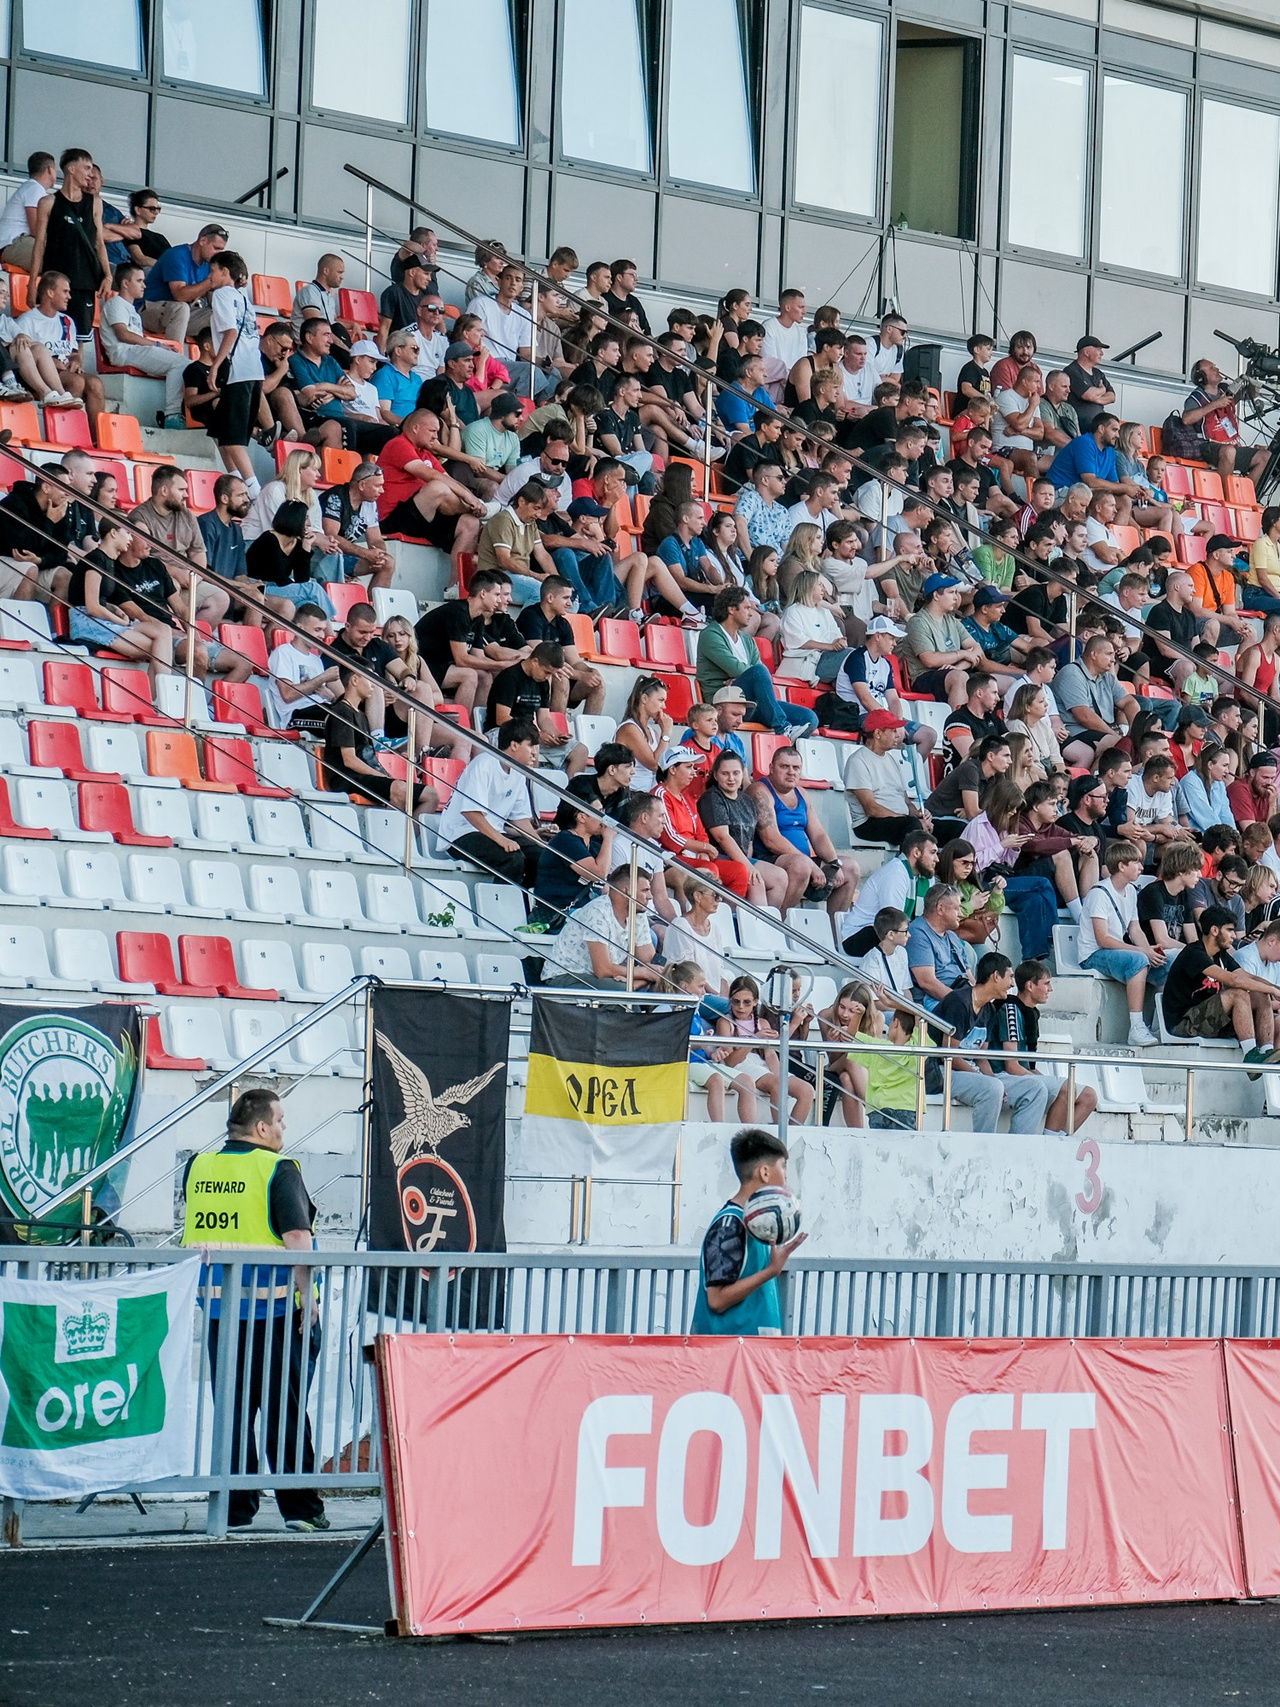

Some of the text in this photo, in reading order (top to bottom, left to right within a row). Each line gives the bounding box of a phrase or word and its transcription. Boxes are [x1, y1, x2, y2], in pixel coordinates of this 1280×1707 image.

[1, 1031, 112, 1205] OREL BUTCHERS
[194, 1181, 246, 1193] STEWARD
[1075, 1139, 1101, 1214] 3
[195, 1211, 239, 1229] 2091
[35, 1363, 138, 1432] orel
[571, 1391, 1096, 1566] FONBET
